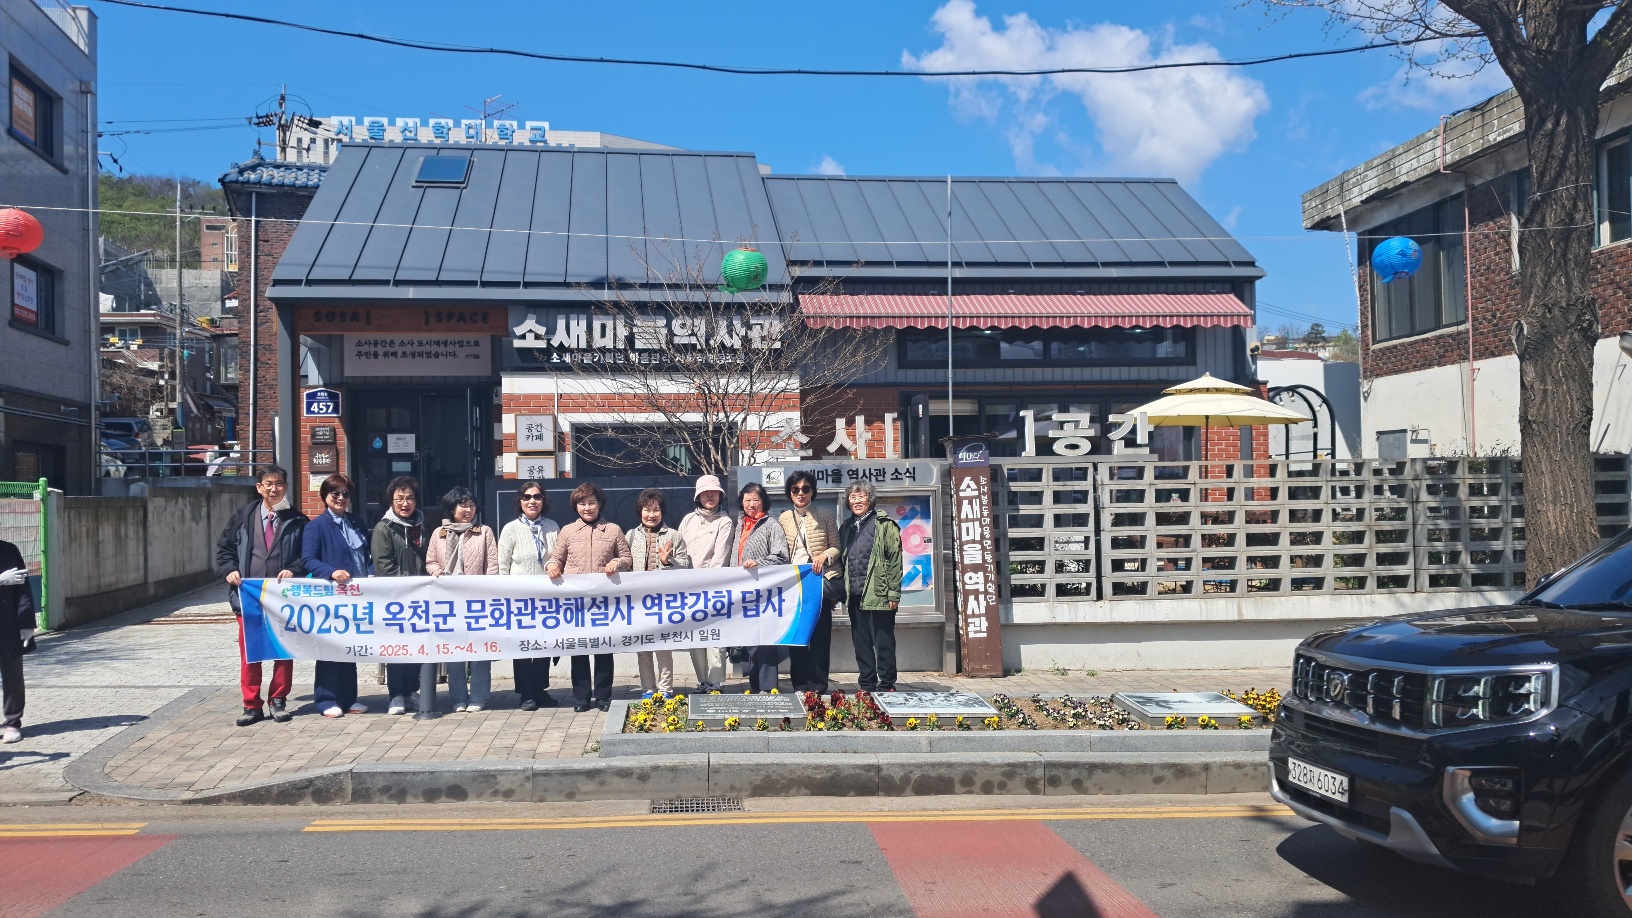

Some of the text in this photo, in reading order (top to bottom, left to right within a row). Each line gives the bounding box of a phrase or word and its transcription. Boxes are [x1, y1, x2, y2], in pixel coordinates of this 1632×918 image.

[334, 118, 549, 143] 서울신학대학교
[355, 339, 480, 348] 소사공간은 소사 도시재생사업으로
[355, 350, 380, 360] 주민을
[381, 350, 398, 359] 위해
[400, 350, 459, 360] 조성되었습니다.
[310, 402, 334, 413] 457
[525, 423, 543, 432] 공간
[525, 433, 544, 442] 카페
[527, 465, 545, 475] 공유
[805, 467, 916, 483] 마을 역사관 소식
[958, 476, 983, 564] 소새마을
[290, 583, 361, 598] 행복드림 옥천
[280, 586, 785, 635] 2025년 옥천군 문화관광해설사 역량강화 답사
[964, 571, 988, 639] 역사관
[345, 645, 373, 657] 기간:
[379, 644, 412, 657] 2025.
[418, 643, 429, 656] 4.
[484, 641, 502, 653] 16.
[518, 639, 548, 652] 장소:
[621, 634, 656, 647] 경기도
[659, 630, 694, 643] 부천시
[698, 628, 721, 641] 일원
